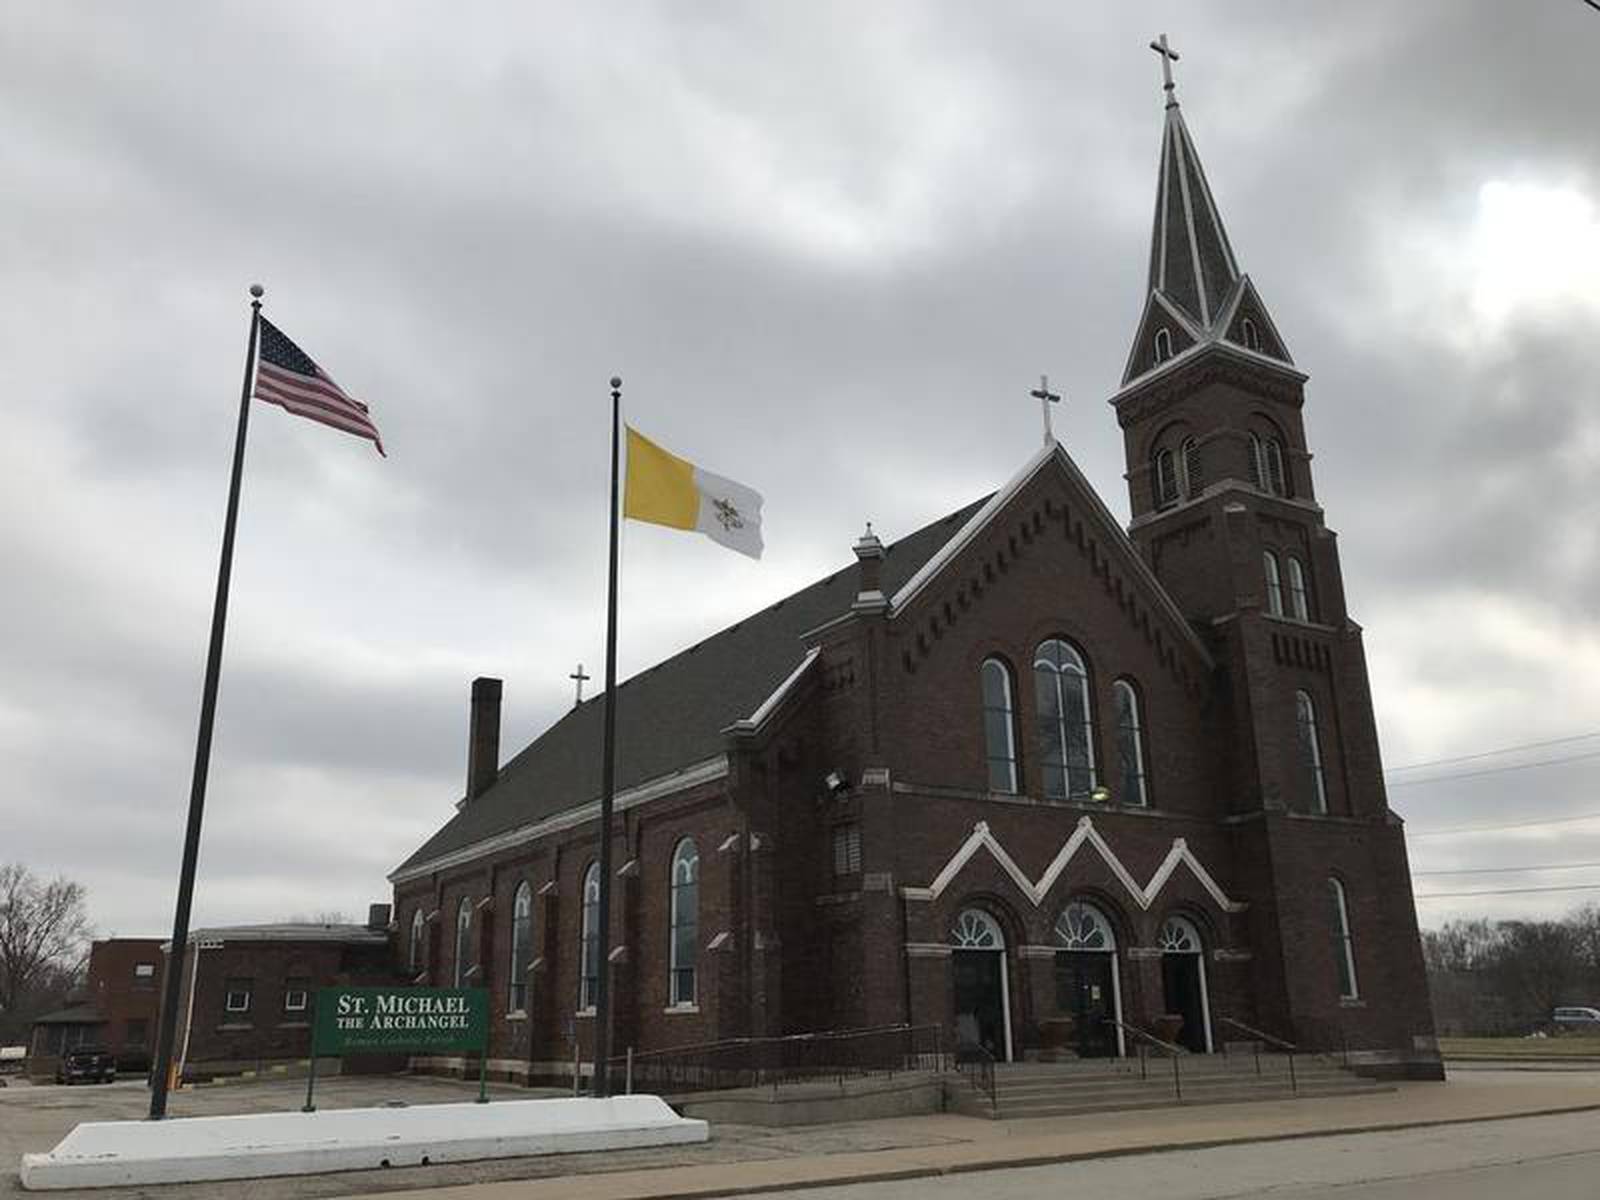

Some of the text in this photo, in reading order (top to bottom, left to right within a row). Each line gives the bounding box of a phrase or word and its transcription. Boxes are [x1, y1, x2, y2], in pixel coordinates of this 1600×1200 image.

[337, 994, 470, 1014] ST. MICHAEL
[337, 1015, 470, 1029] THE ARCHANGEL
